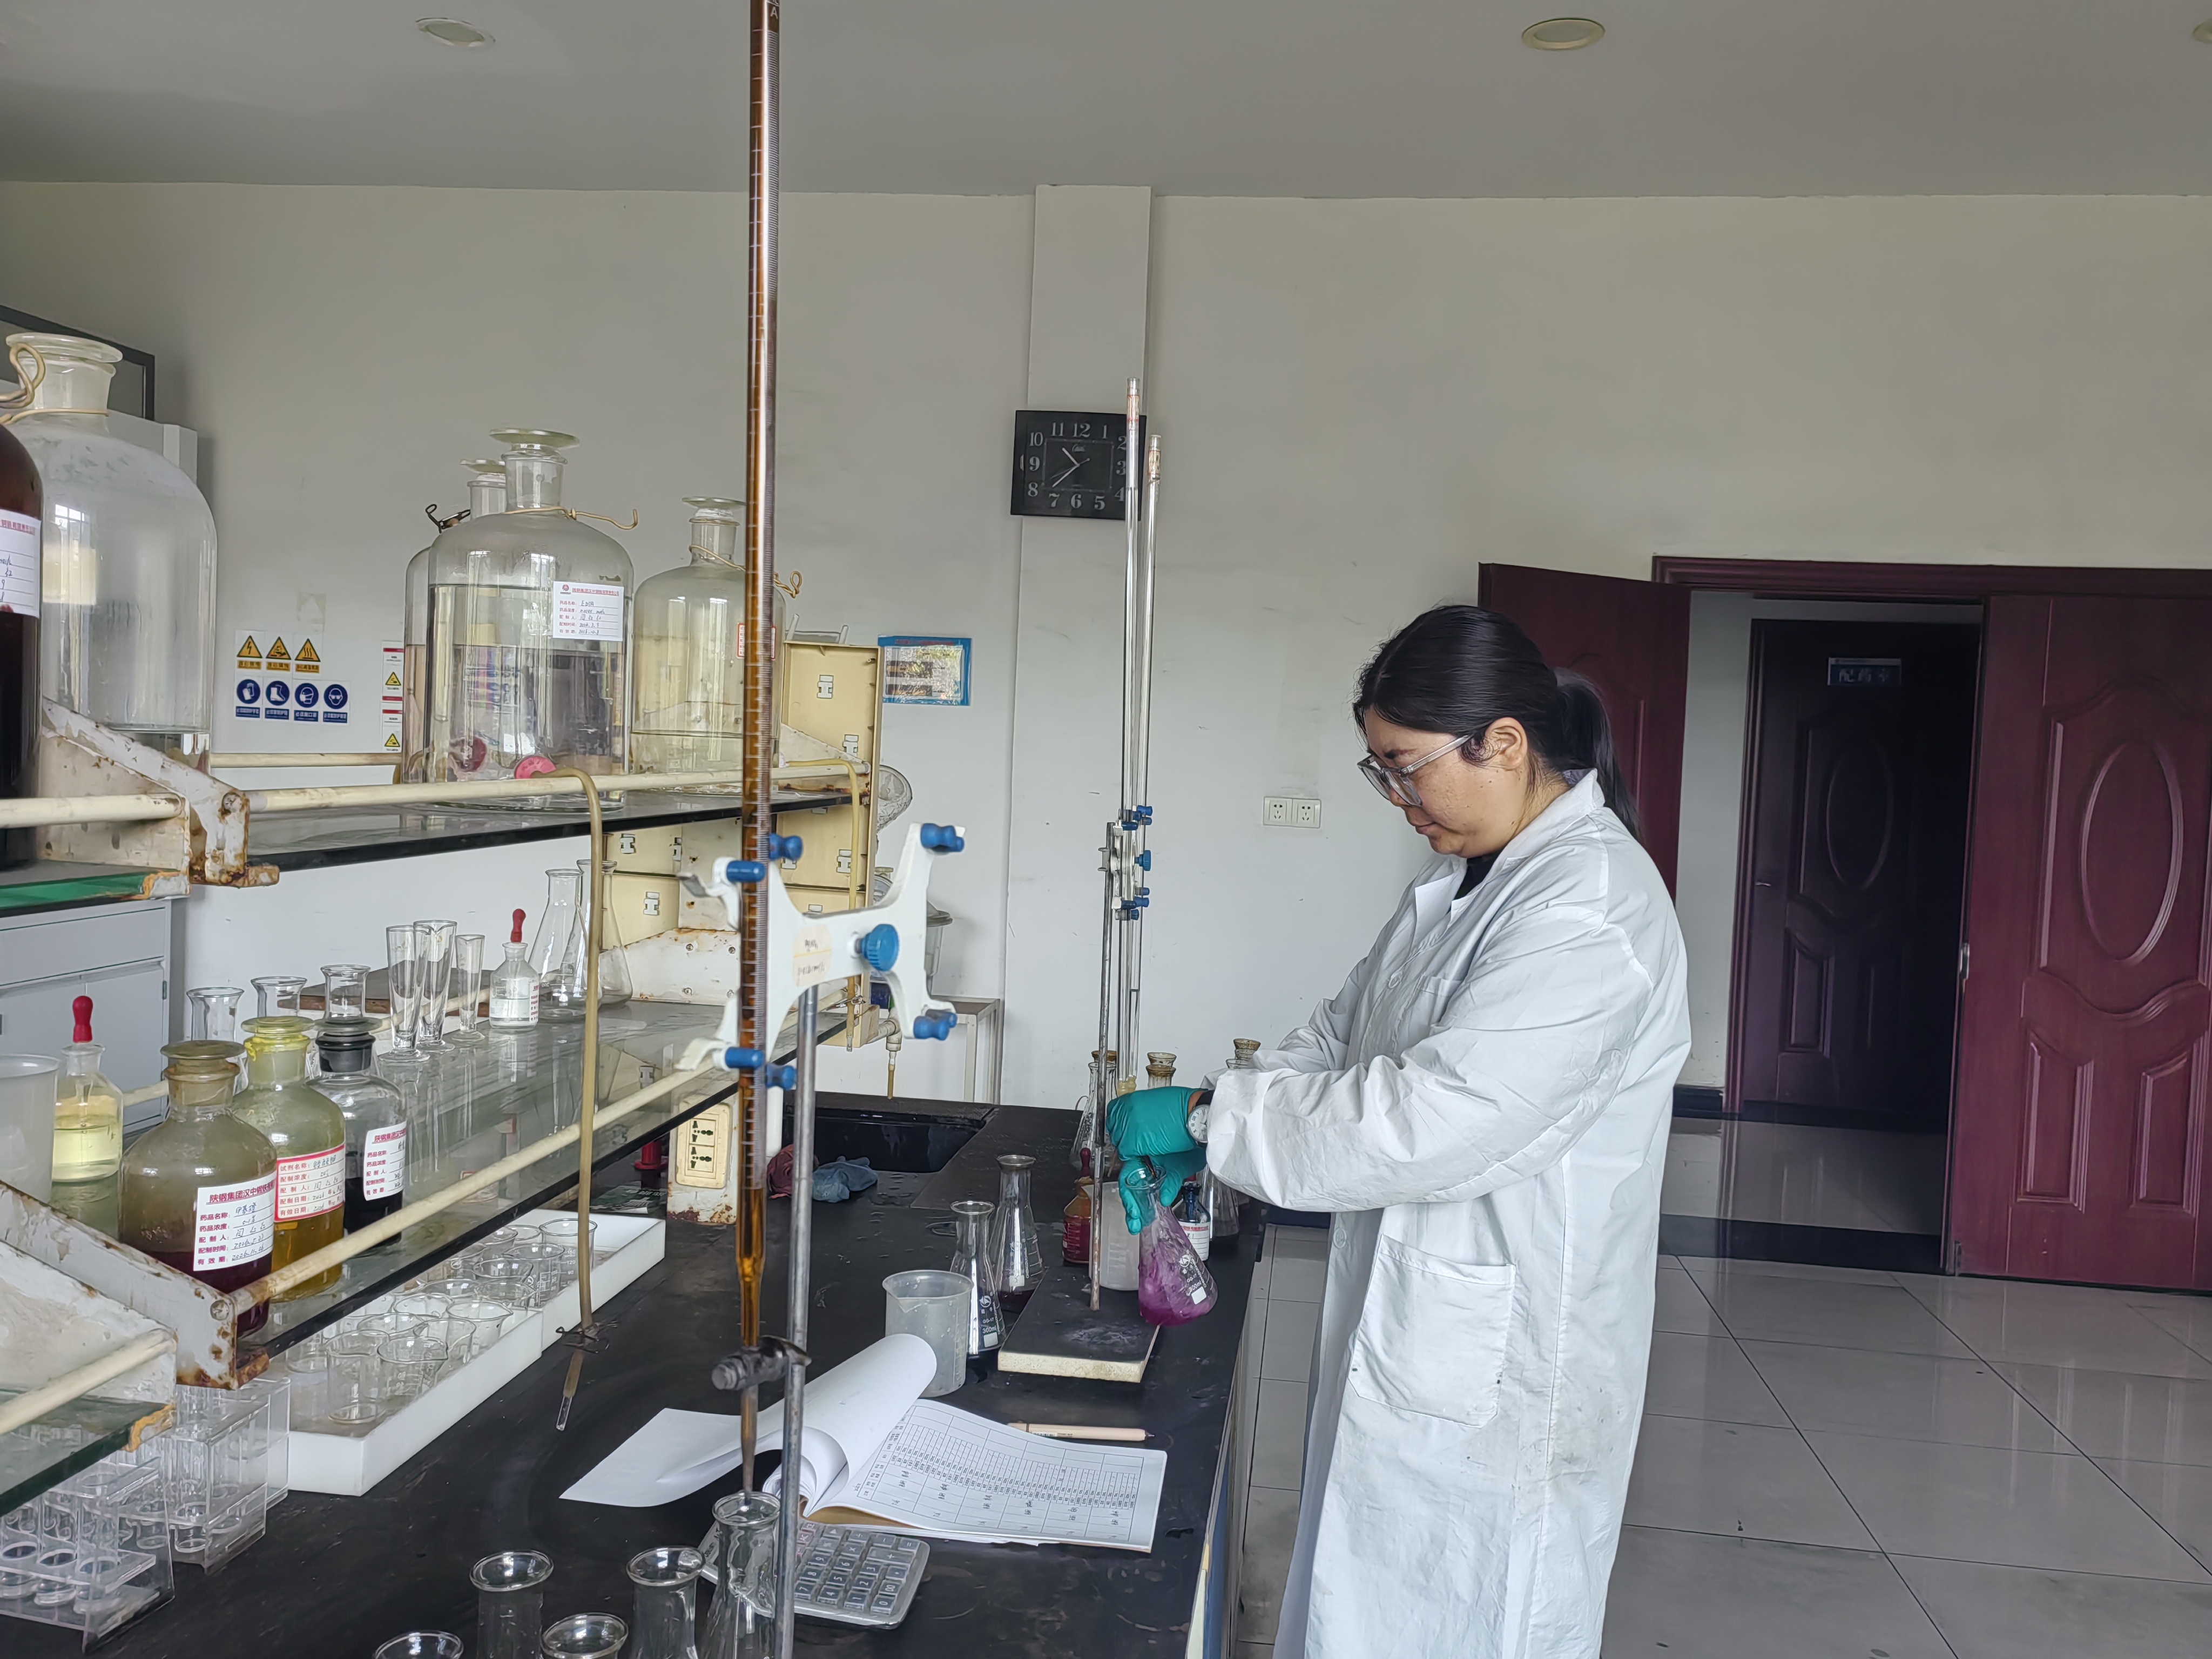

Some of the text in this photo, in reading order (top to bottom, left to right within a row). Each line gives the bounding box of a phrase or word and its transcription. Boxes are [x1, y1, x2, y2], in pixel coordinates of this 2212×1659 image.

[770, 6, 778, 20] A
[1051, 422, 1064, 436] 11
[1073, 422, 1091, 437] 12
[1102, 424, 1108, 439] 1
[1029, 432, 1043, 446] 10
[1117, 436, 1127, 450] 2
[1029, 456, 1040, 471] 9
[1116, 461, 1126, 476] 3
[1028, 482, 1038, 497] 8
[1114, 487, 1125, 502] 4
[1049, 493, 1060, 508] 7
[1070, 494, 1082, 509] 6
[1094, 496, 1105, 510] 5
